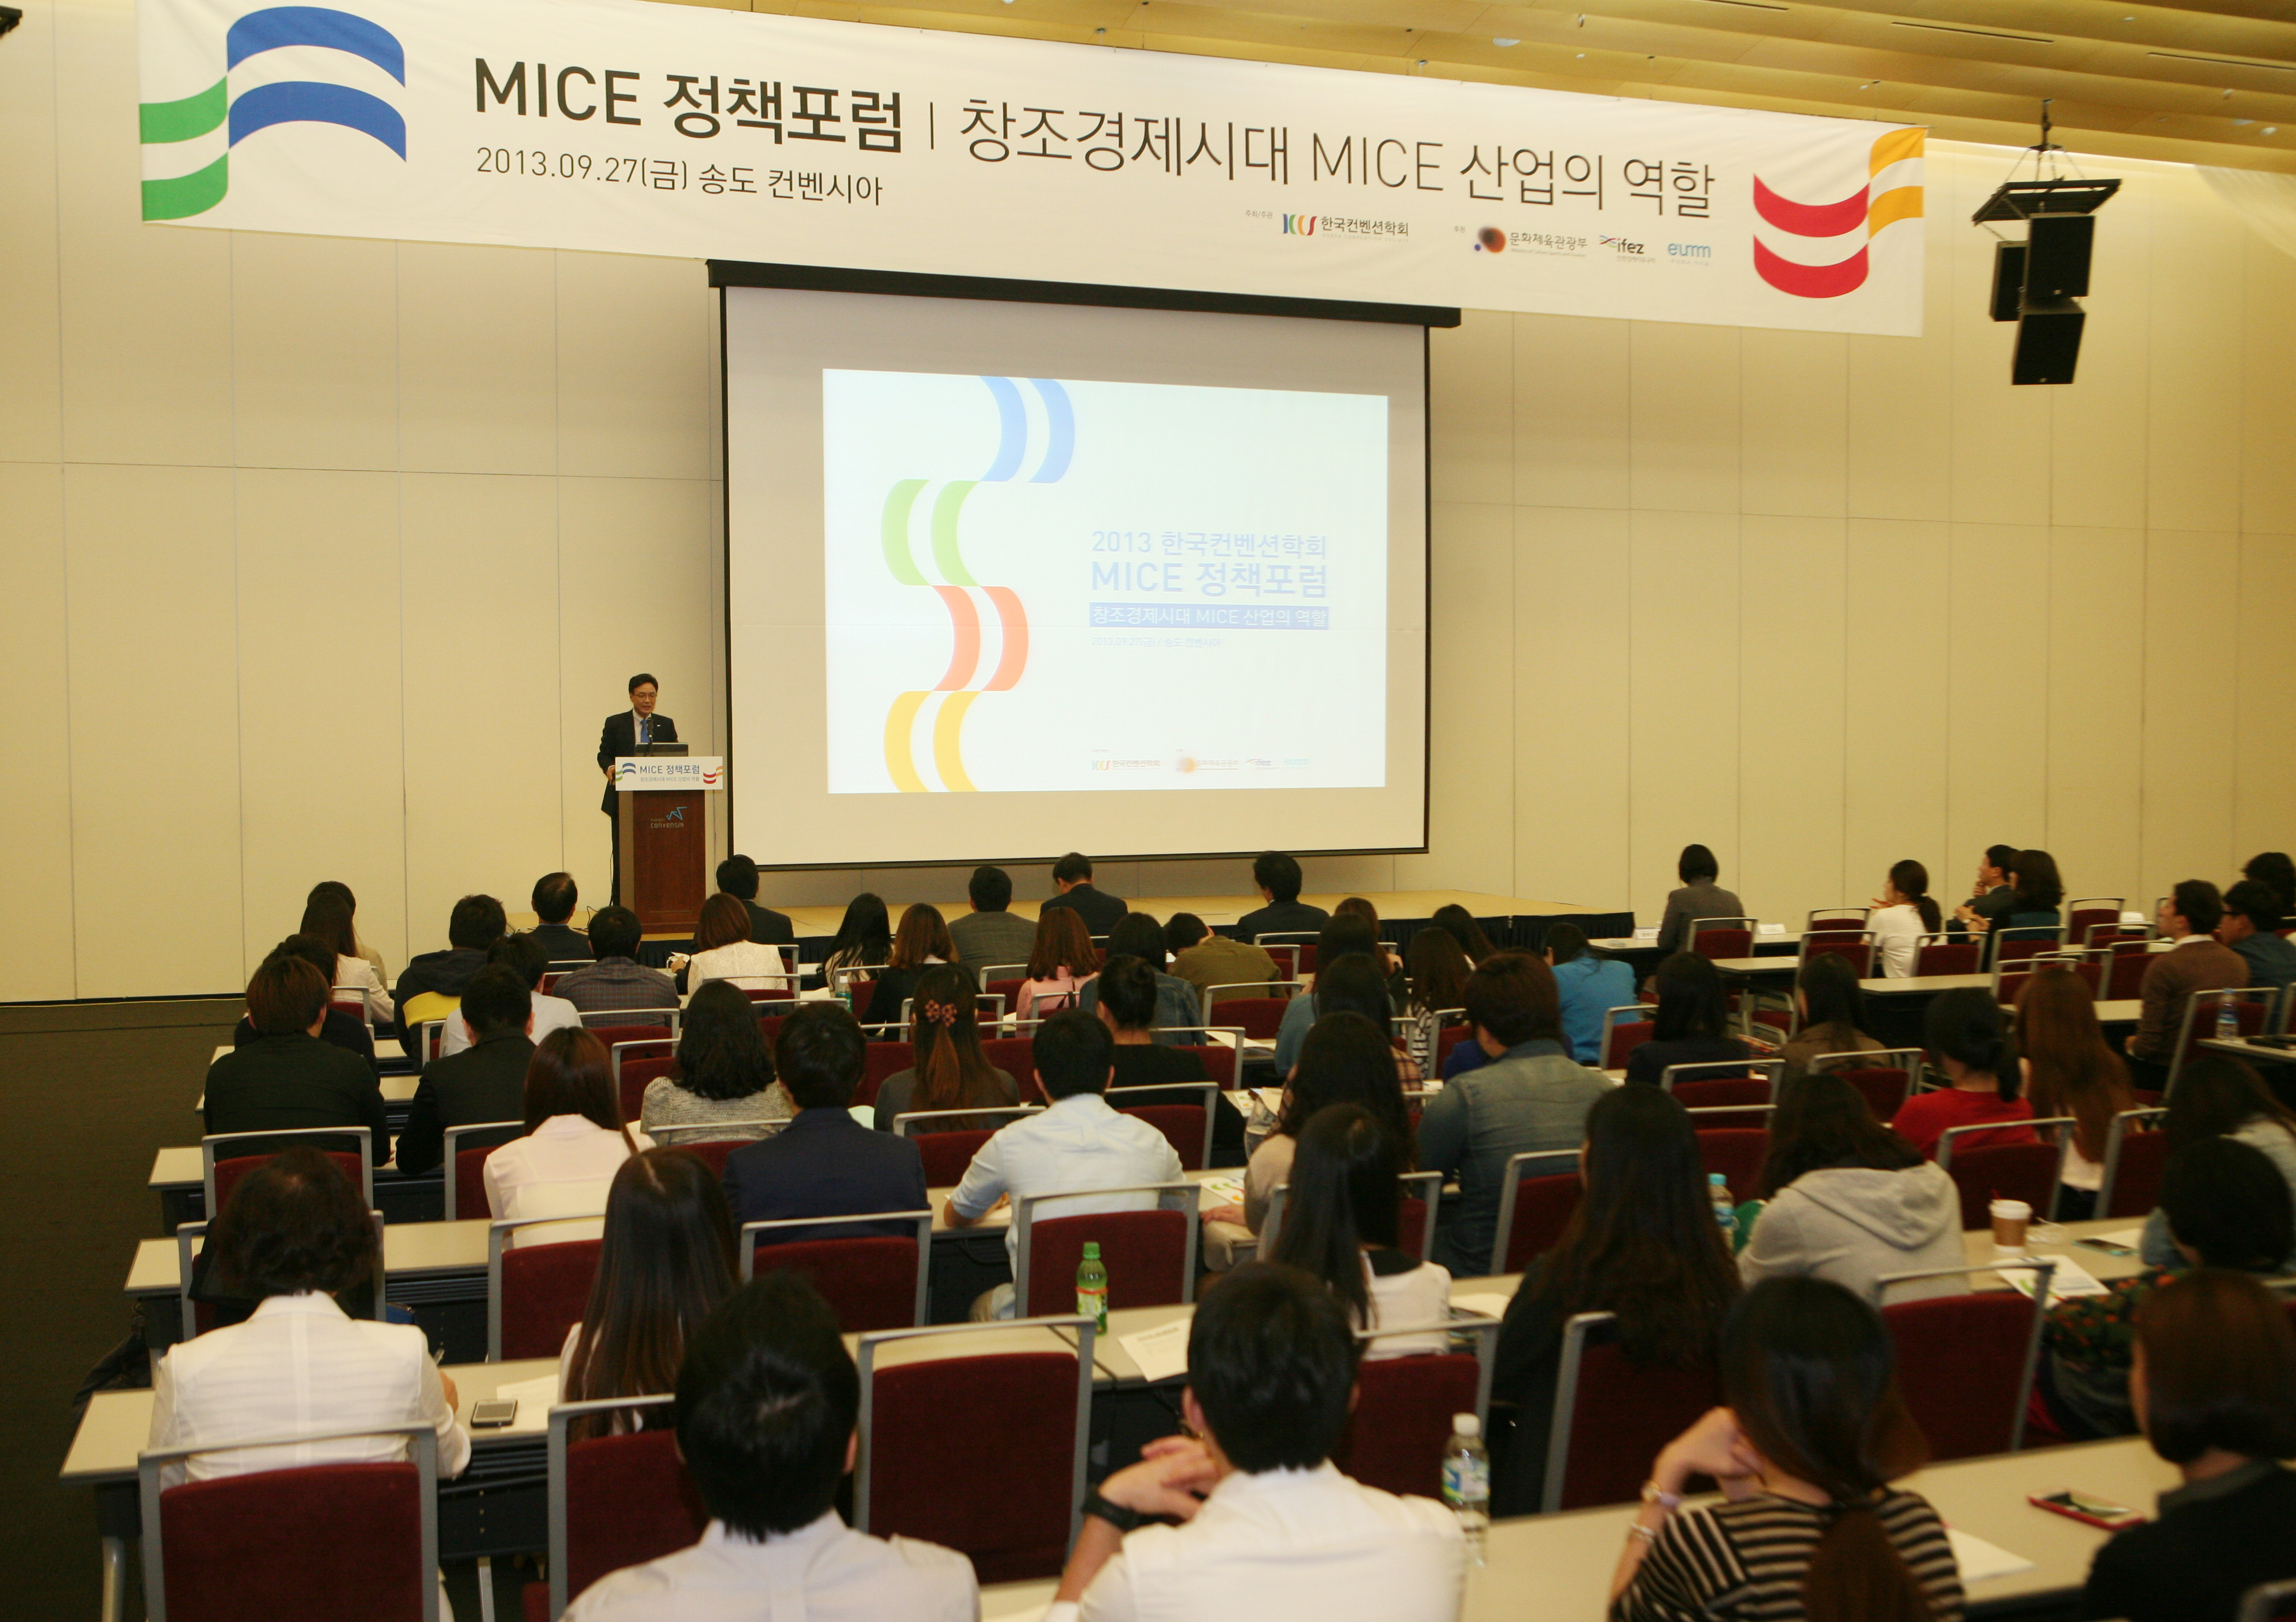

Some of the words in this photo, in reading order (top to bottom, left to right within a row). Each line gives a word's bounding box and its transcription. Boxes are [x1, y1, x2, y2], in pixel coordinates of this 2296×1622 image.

[475, 57, 642, 126] MICE
[663, 73, 902, 153] 정책포럼
[961, 99, 1289, 185] 창조경제시대
[1313, 132, 1444, 191] MICE
[1460, 145, 1603, 211] 산업의
[1623, 159, 1715, 219] 역할
[476, 147, 687, 190] 2013.09.27(금)
[699, 164, 758, 194] 송도
[768, 169, 883, 206] 컨벤시아
[1320, 216, 1409, 237] 한국컨벤션학회
[1509, 232, 1588, 251] 문화체육관광부
[1617, 238, 1644, 254] ifez
[1092, 530, 1151, 553] 2013
[1161, 531, 1326, 559] 한국컨벤션학회
[1092, 561, 1183, 592] MICE
[1196, 562, 1326, 598] 정책포럼
[1093, 606, 1190, 625] 창조경제시대
[1197, 609, 1239, 624] MICE
[1243, 609, 1290, 626] 산업의
[1296, 609, 1327, 628] 역할
[640, 765, 663, 774] MICE
[666, 765, 700, 775] 정책포럼
